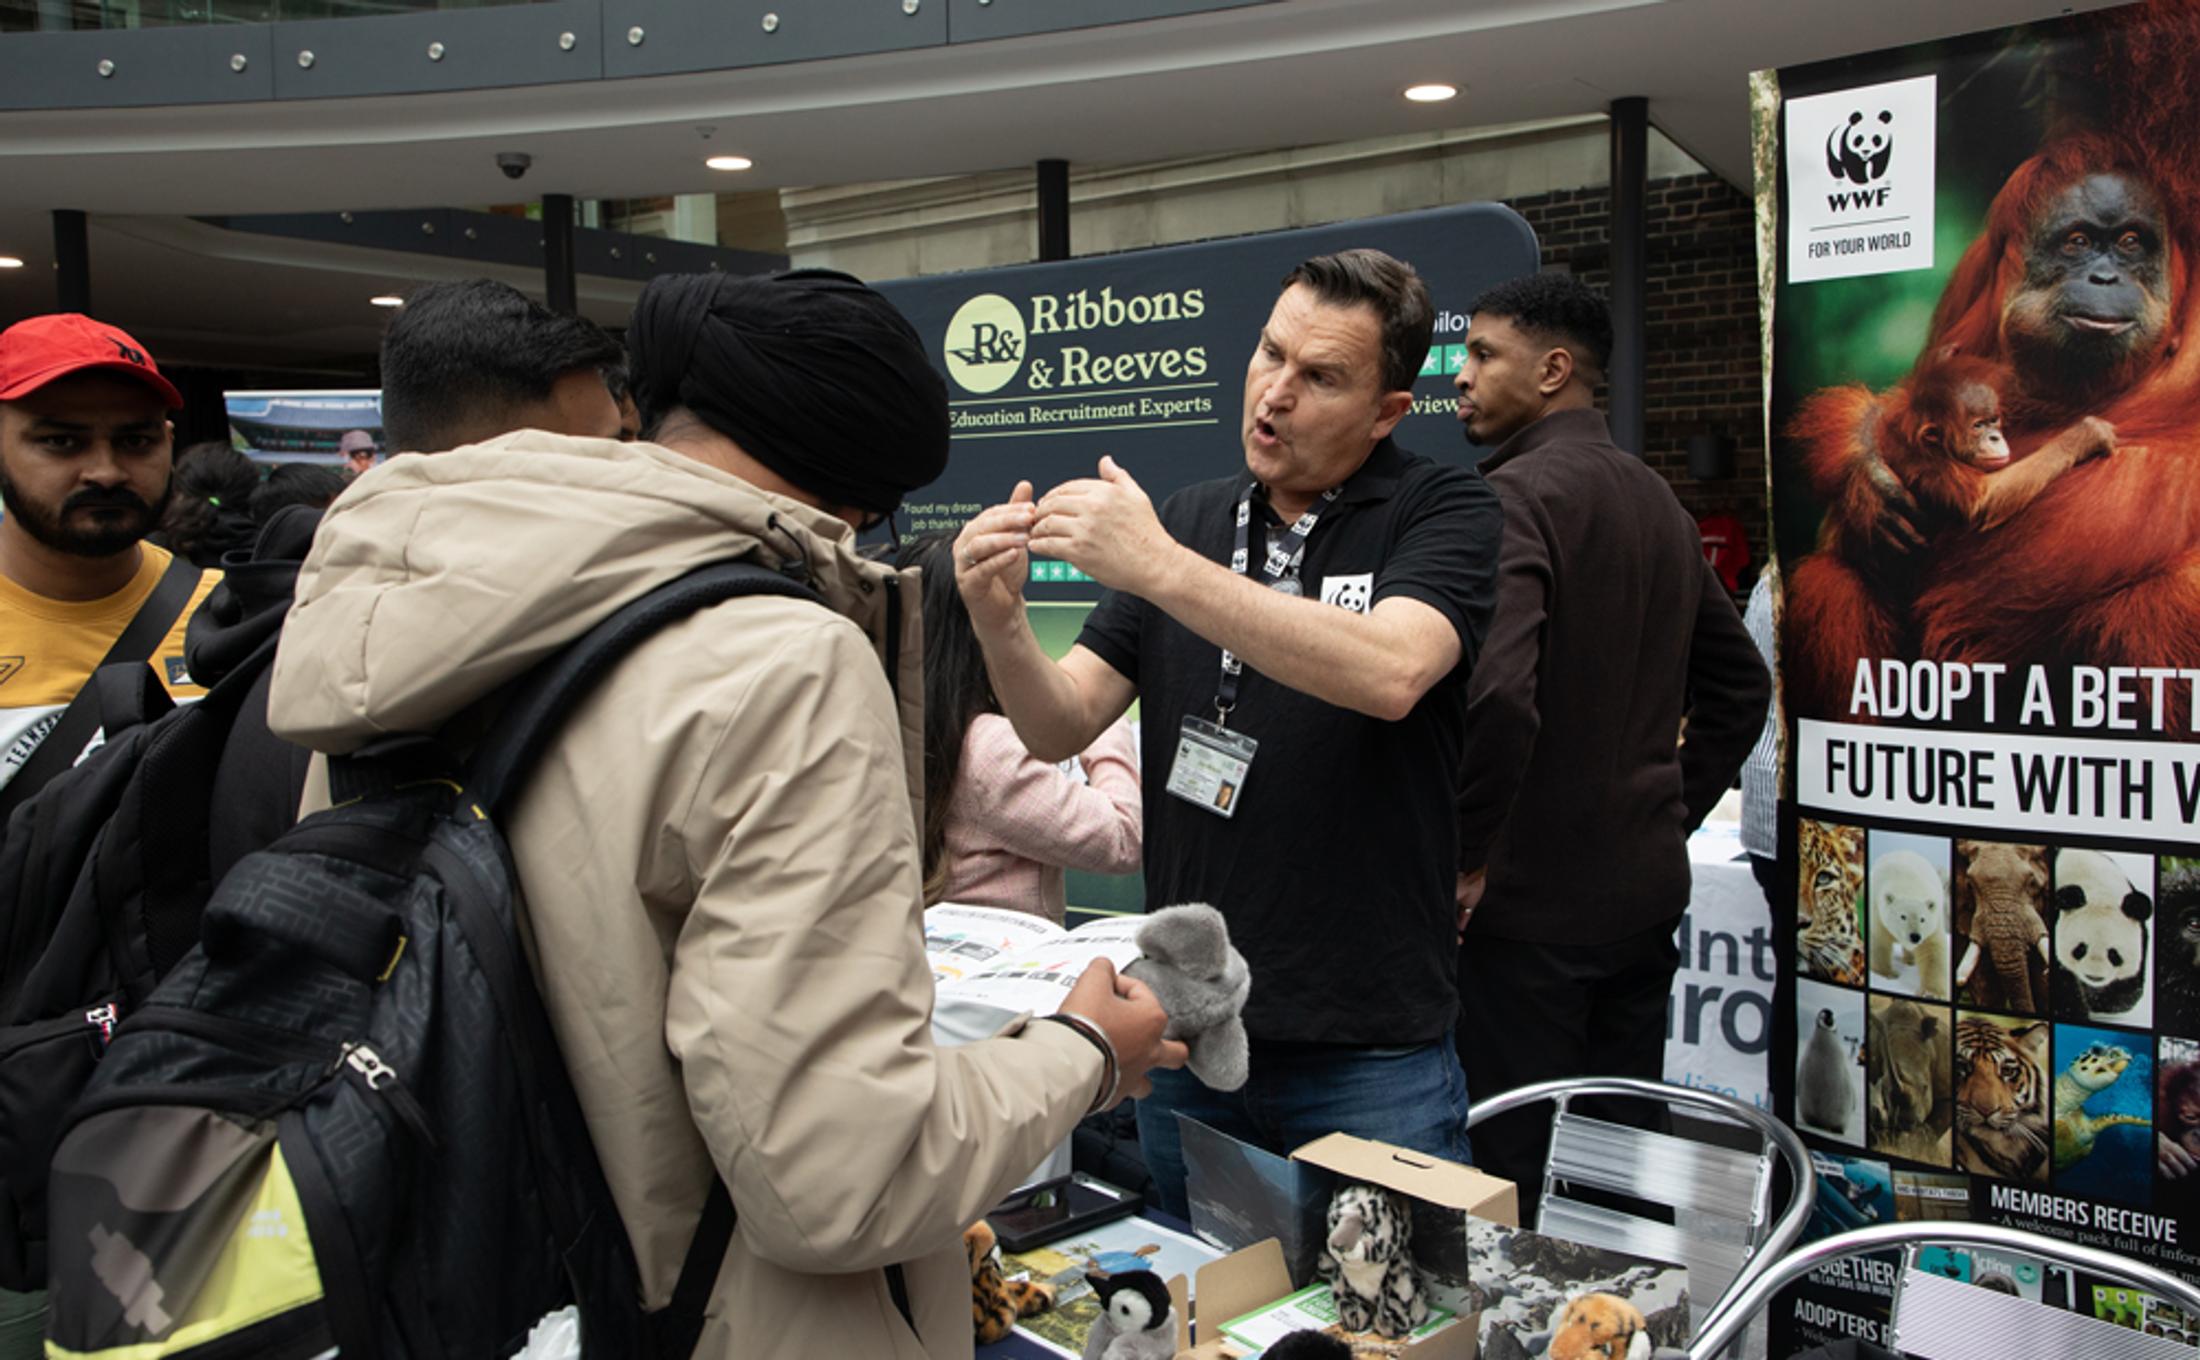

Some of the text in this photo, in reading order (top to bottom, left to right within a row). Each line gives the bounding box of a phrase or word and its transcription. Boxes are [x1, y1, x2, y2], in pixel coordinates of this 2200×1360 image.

[1827, 187, 1891, 213] WWF
[1808, 231, 1911, 258] FOR YOUR WORLD
[1029, 286, 1205, 335] Ribbons
[1028, 346, 1208, 390] & Reeves
[1029, 401, 1137, 424] Recruitment
[1139, 396, 1212, 419] Experts
[911, 519, 927, 532] job
[928, 519, 959, 529] thanks
[935, 504, 949, 516] my
[951, 502, 982, 513] dream
[1849, 657, 2200, 733] ADOPT A BETT
[1825, 738, 1995, 810] FUTURE
[2011, 752, 2153, 821] WITH
[1990, 1184, 2177, 1243] MEMBERS RECEIVE
[2001, 1215, 2013, 1227] A
[2015, 1218, 2075, 1239] welcome
[2078, 1231, 2111, 1248] pack
[2114, 1236, 2139, 1252] full
[2142, 1243, 2158, 1256] of
[1818, 1256, 1896, 1286] OGETHER
[1794, 1297, 1878, 1342] ADOPTERS
